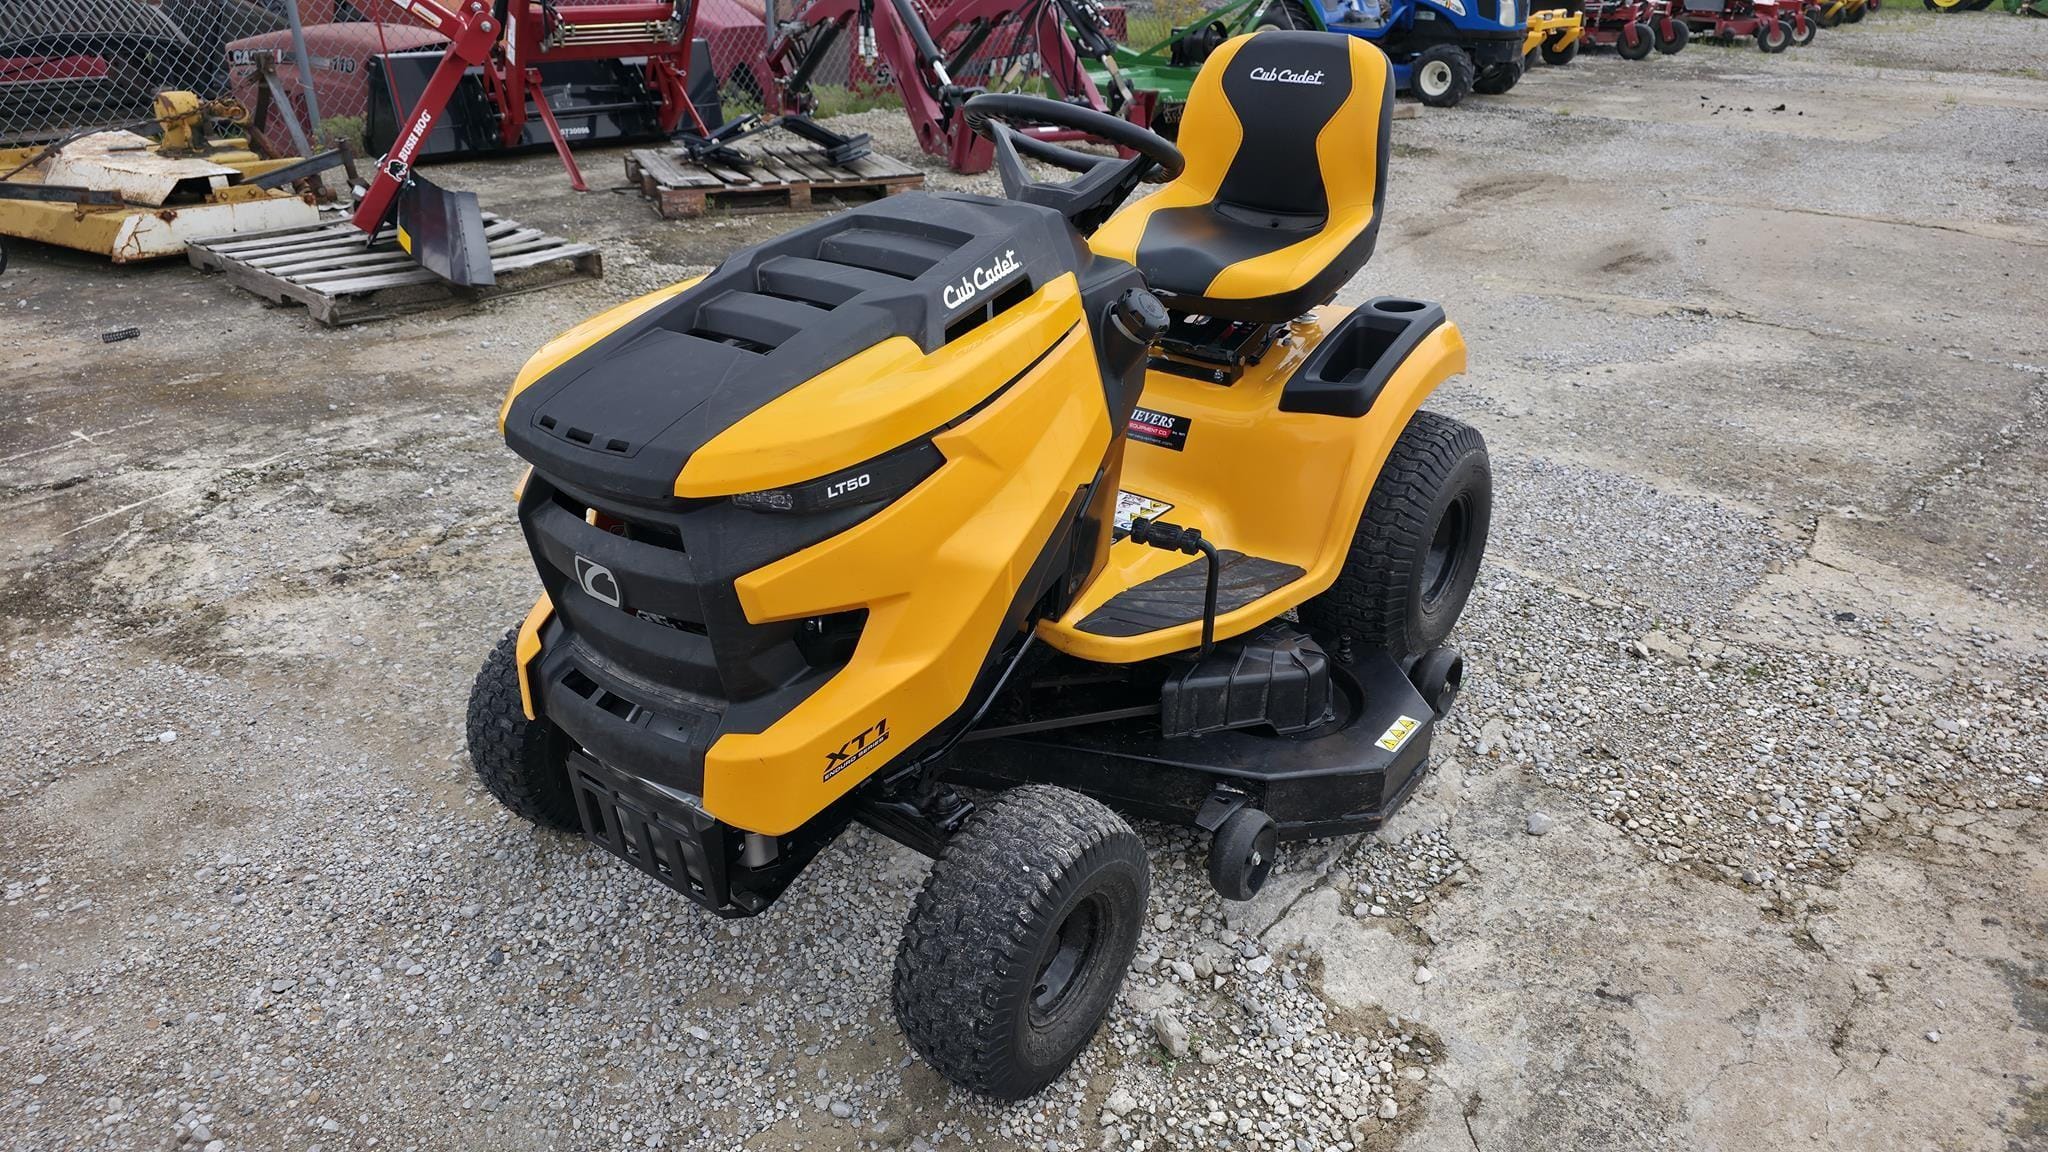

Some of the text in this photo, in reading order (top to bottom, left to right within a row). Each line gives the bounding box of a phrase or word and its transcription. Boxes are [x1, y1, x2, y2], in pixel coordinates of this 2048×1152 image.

[1250, 67, 1325, 85] Cub Cadet
[398, 109, 432, 162] BUSH HOG
[943, 250, 1021, 310] Cub Cadet
[827, 473, 871, 498] LT50
[823, 717, 887, 773] XT1
[824, 736, 885, 781] ENDURO SERIES
